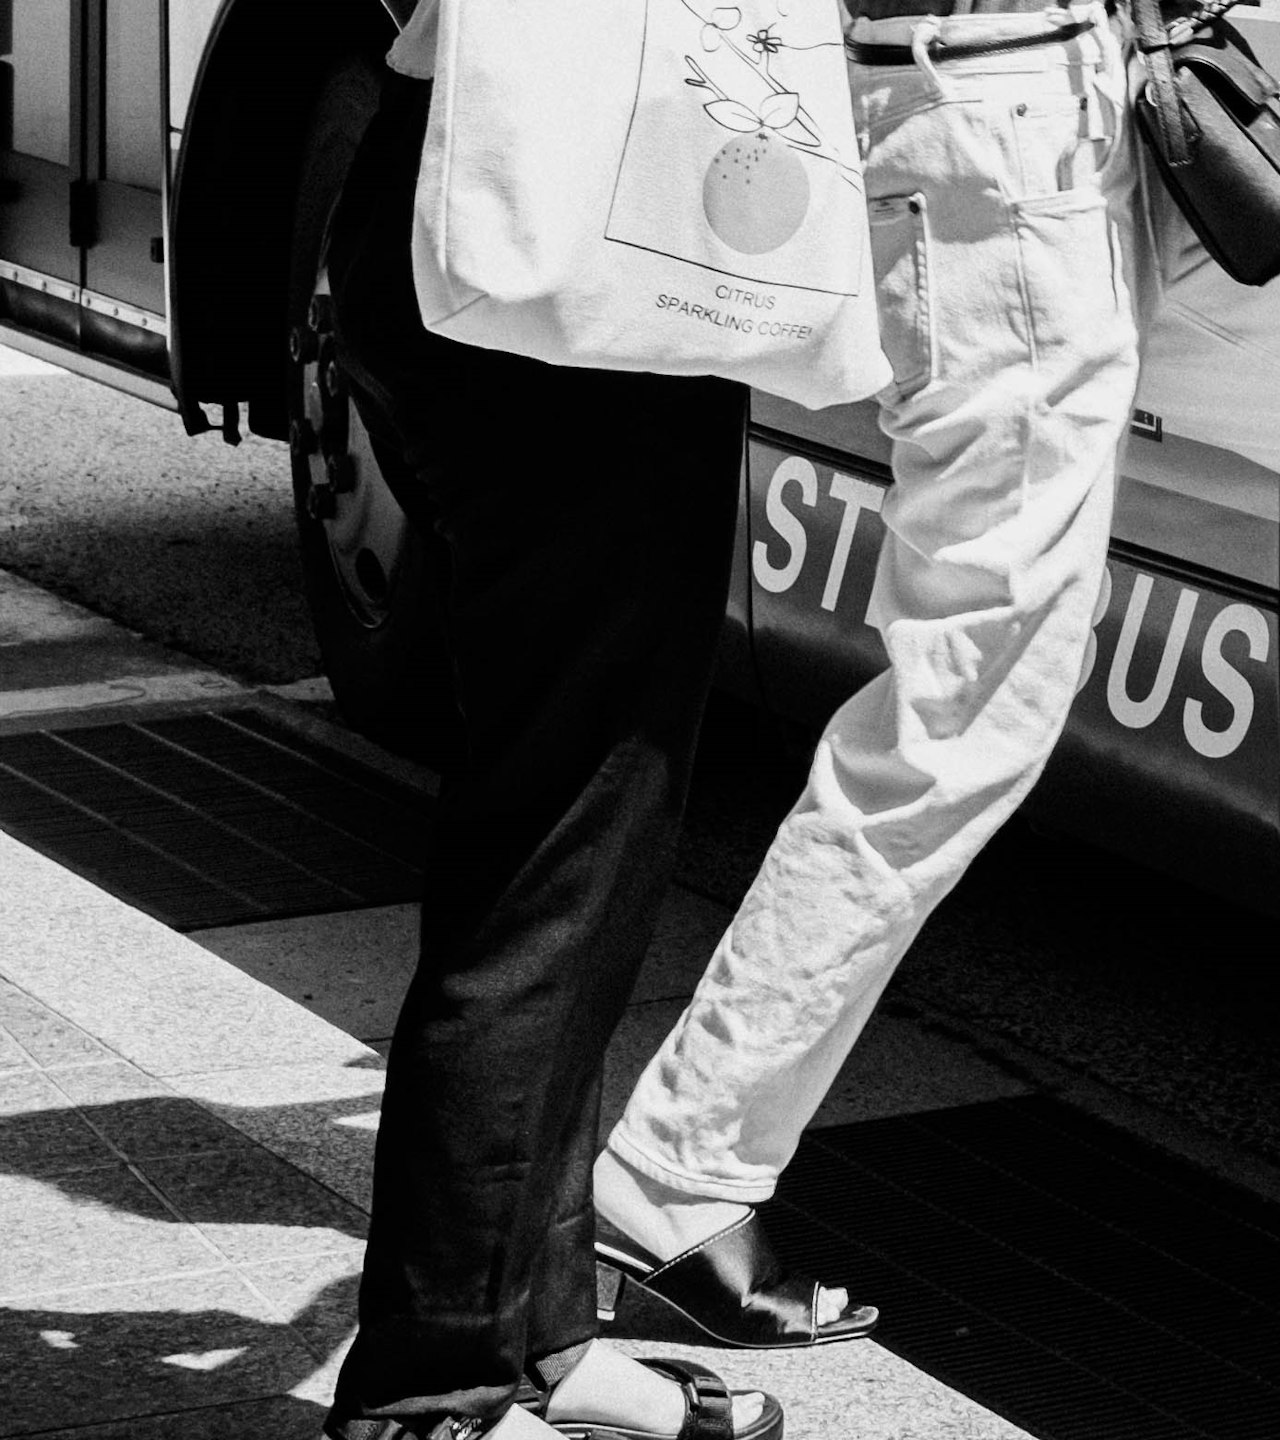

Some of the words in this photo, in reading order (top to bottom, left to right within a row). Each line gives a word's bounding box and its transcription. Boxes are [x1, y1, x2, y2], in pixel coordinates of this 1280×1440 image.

[715, 285, 776, 310] CITRUS
[656, 294, 752, 333] SPARKLING
[758, 321, 813, 339] COFFE
